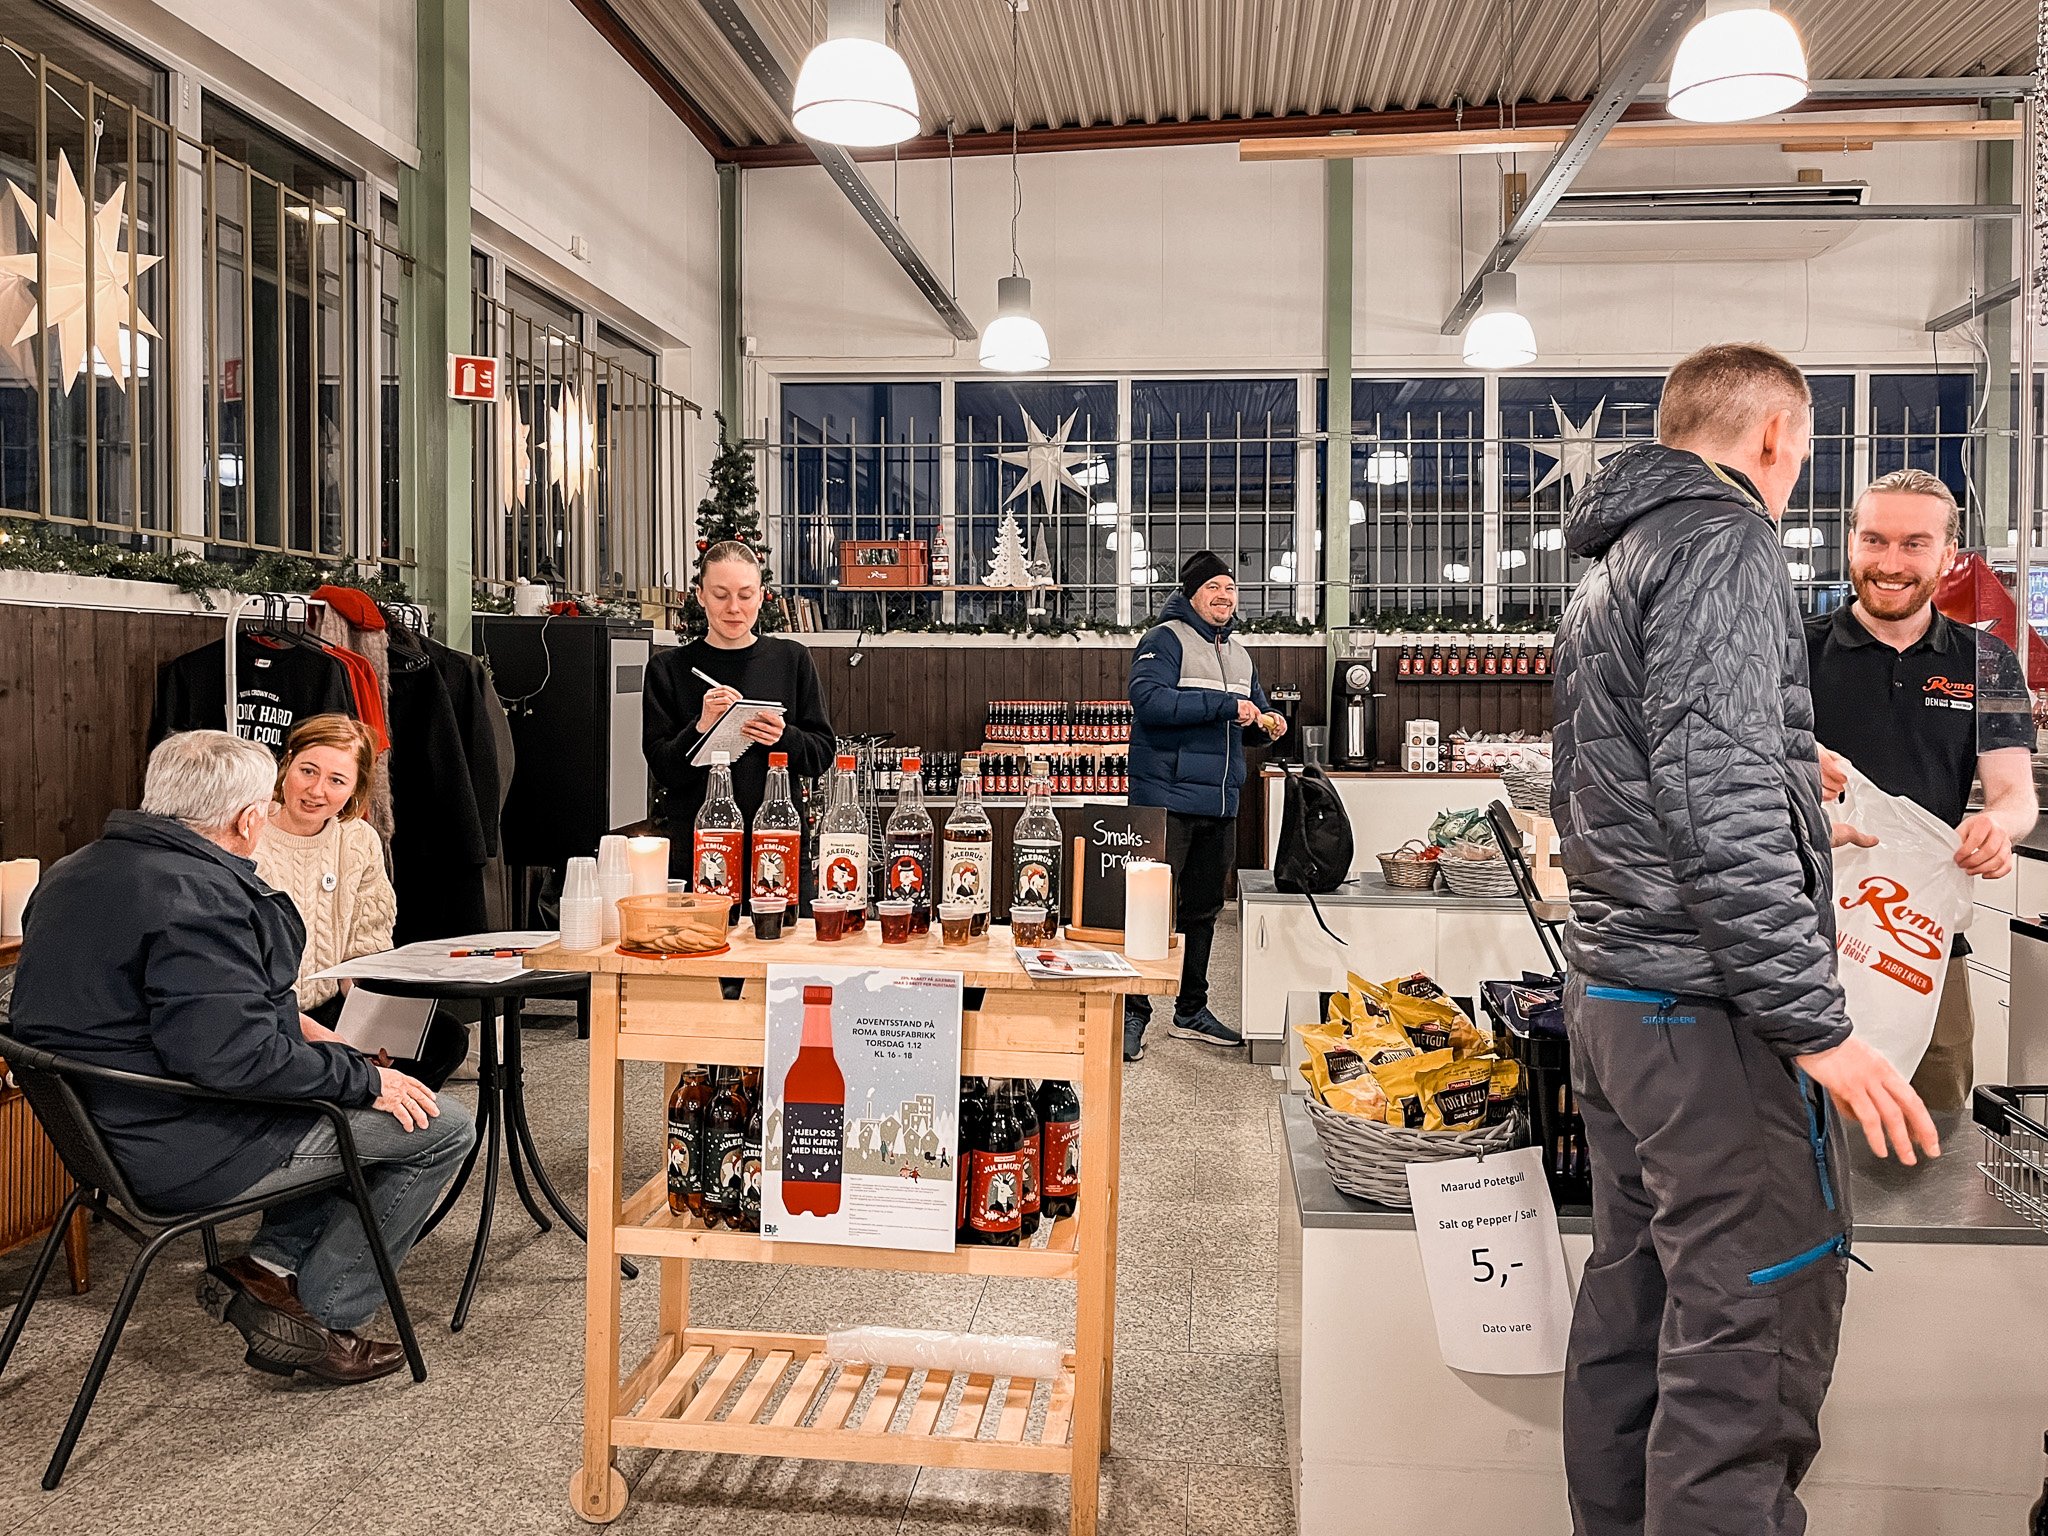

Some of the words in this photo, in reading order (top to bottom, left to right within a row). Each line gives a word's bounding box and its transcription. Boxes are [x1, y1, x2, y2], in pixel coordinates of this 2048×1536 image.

[1922, 676, 1974, 698] Roma
[224, 703, 257, 721] ORK
[259, 705, 293, 727] HARD
[254, 725, 282, 746] COOL
[1092, 820, 1151, 847] Smaks-
[696, 842, 732, 853] JULEMUST
[755, 843, 791, 854] JULEMUST
[826, 847, 860, 858] JULEBRUS
[890, 849, 924, 860] JULEBRUS
[950, 851, 984, 861] JULEBRUS
[1018, 853, 1053, 866] JULEBRUS
[1839, 876, 1944, 960] Roma
[1849, 936, 1873, 955] LILLE
[1842, 943, 1867, 964] BRUS
[1880, 959, 1928, 989] FABRIKKEN
[856, 1017, 922, 1028] ADVENTSSTAND
[924, 1019, 935, 1029] PÅ
[852, 1028, 878, 1036] ROMA
[880, 1029, 936, 1040] BRUSFABRIKK
[865, 1039, 905, 1048] TORSDAG
[907, 1041, 922, 1050] 1.12
[874, 1050, 885, 1058] KL
[887, 1051, 896, 1059] 16
[668, 1127, 695, 1141] LEBRUS
[794, 1128, 819, 1137] HJELP
[819, 1129, 836, 1137] OSS
[1060, 1128, 1079, 1143] JULE
[719, 1138, 743, 1151] JULEB
[790, 1135, 798, 1145] Å
[799, 1137, 811, 1145] BLI
[812, 1138, 839, 1147] KJENT
[791, 1146, 811, 1155] MED
[983, 1162, 1021, 1174] JULEMUST
[1441, 1178, 1482, 1193] Maarud
[1484, 1172, 1525, 1189] Potetgull
[1438, 1219, 1459, 1230] Salt
[1461, 1219, 1475, 1230] og
[1476, 1213, 1512, 1228] Pepper
[1520, 1208, 1538, 1220] Salt
[1471, 1247, 1524, 1288] 5,-
[1482, 1323, 1507, 1334] Dato
[1509, 1322, 1532, 1333] vare
